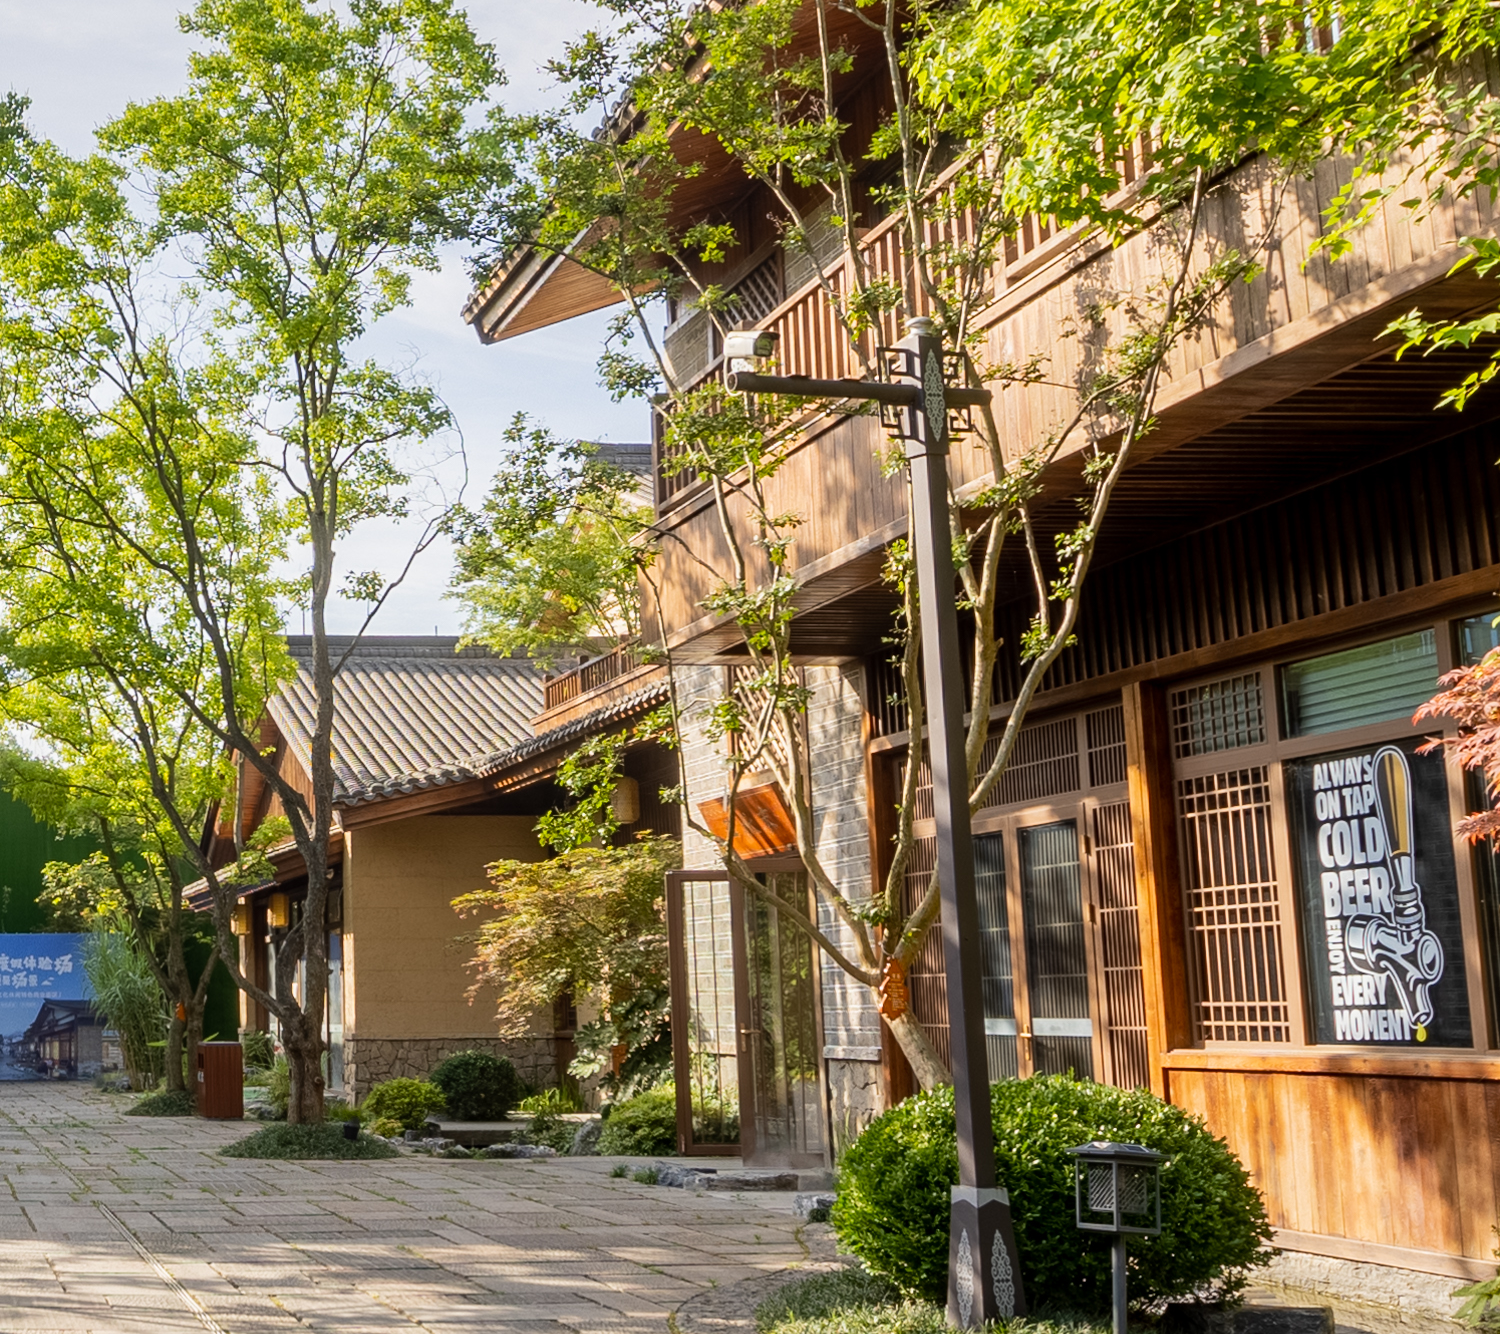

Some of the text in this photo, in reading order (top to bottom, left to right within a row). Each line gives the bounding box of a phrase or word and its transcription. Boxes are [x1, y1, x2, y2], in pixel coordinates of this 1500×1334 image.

[1313, 755, 1373, 791] ALWAYS
[1315, 784, 1375, 821] ON TAP
[1318, 817, 1385, 868] COLD
[1321, 867, 1394, 918] BEER
[1325, 919, 1346, 975] ENJOY
[1331, 974, 1388, 1006] EVERY
[1333, 1009, 1412, 1041] MOMENT
